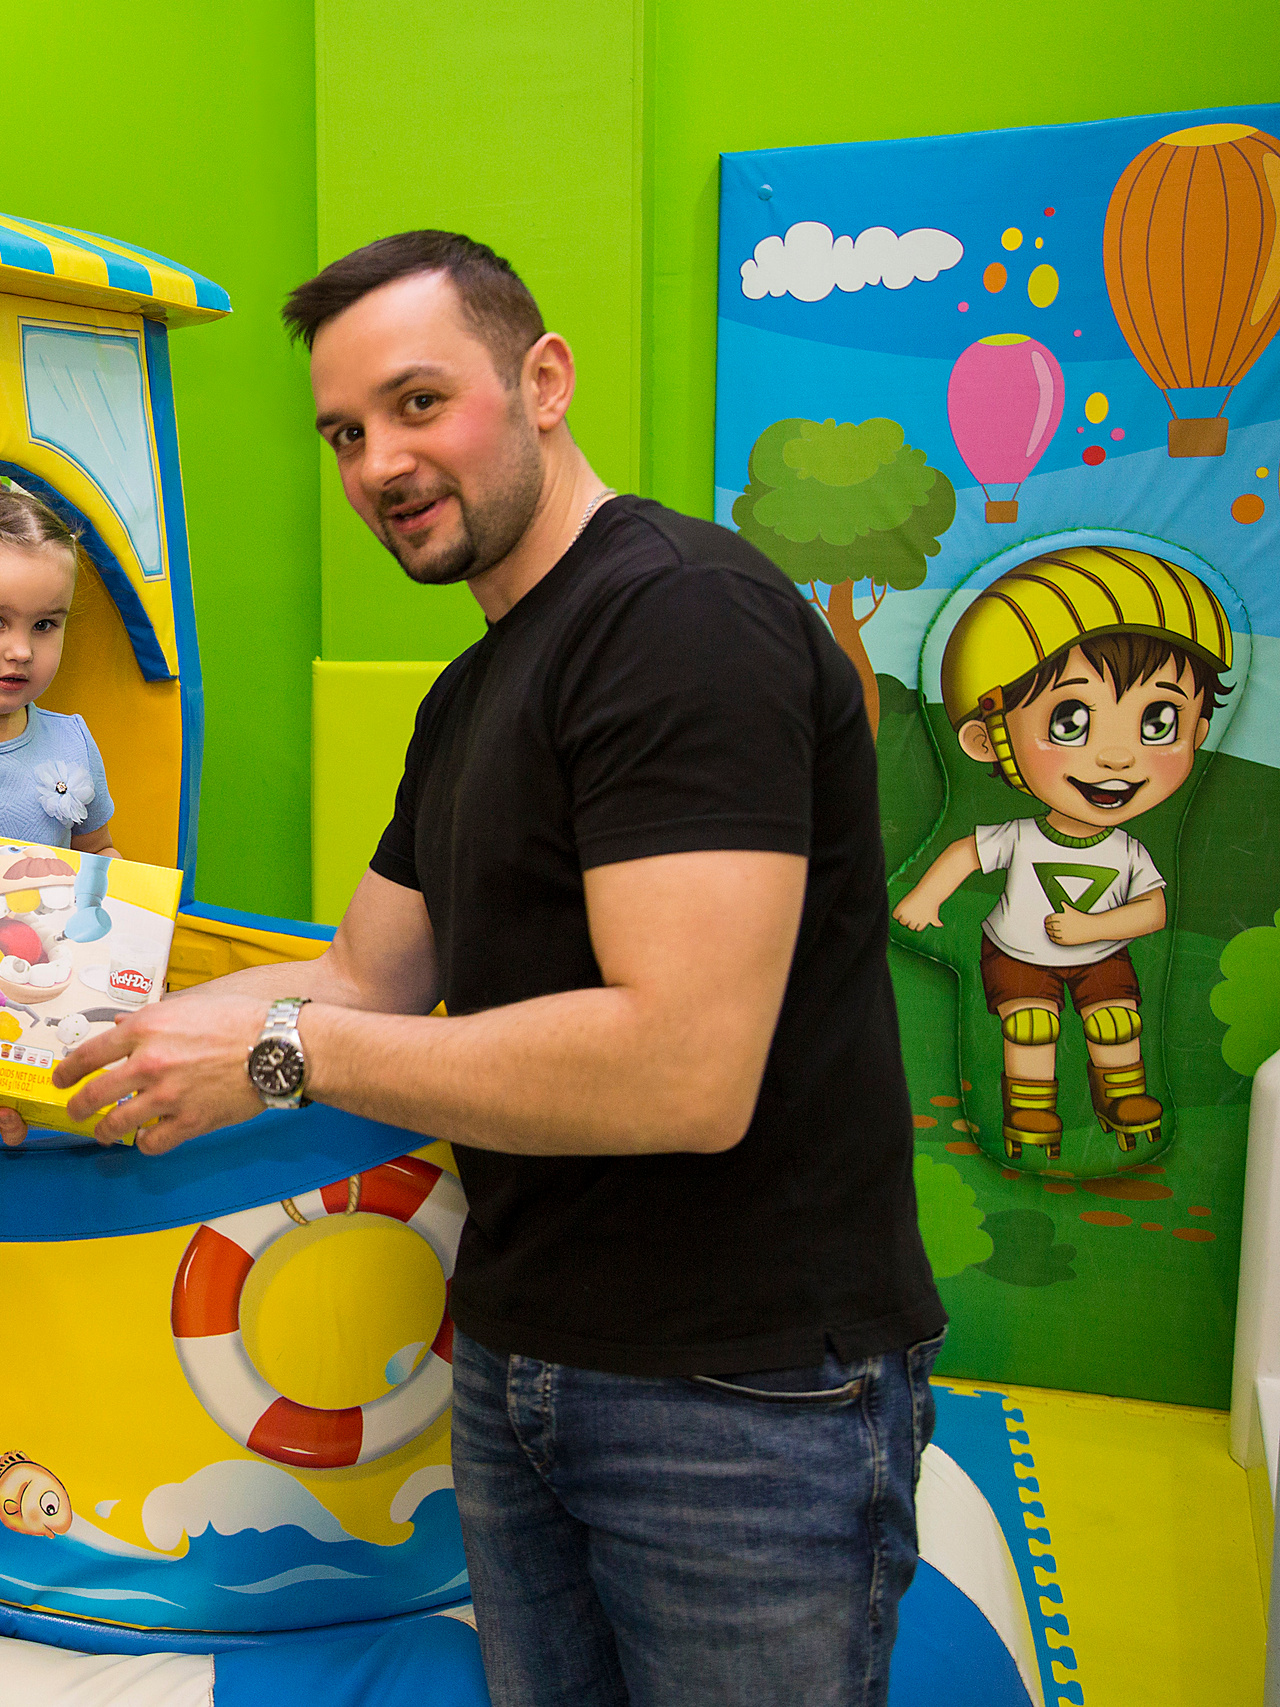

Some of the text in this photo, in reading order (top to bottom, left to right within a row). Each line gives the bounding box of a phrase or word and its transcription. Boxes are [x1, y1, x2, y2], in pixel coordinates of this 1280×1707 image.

[110, 970, 154, 993] Play-Doh
[15, 1070, 28, 1081] NET
[28, 1073, 37, 1083] DE
[37, 1075, 45, 1085] LA
